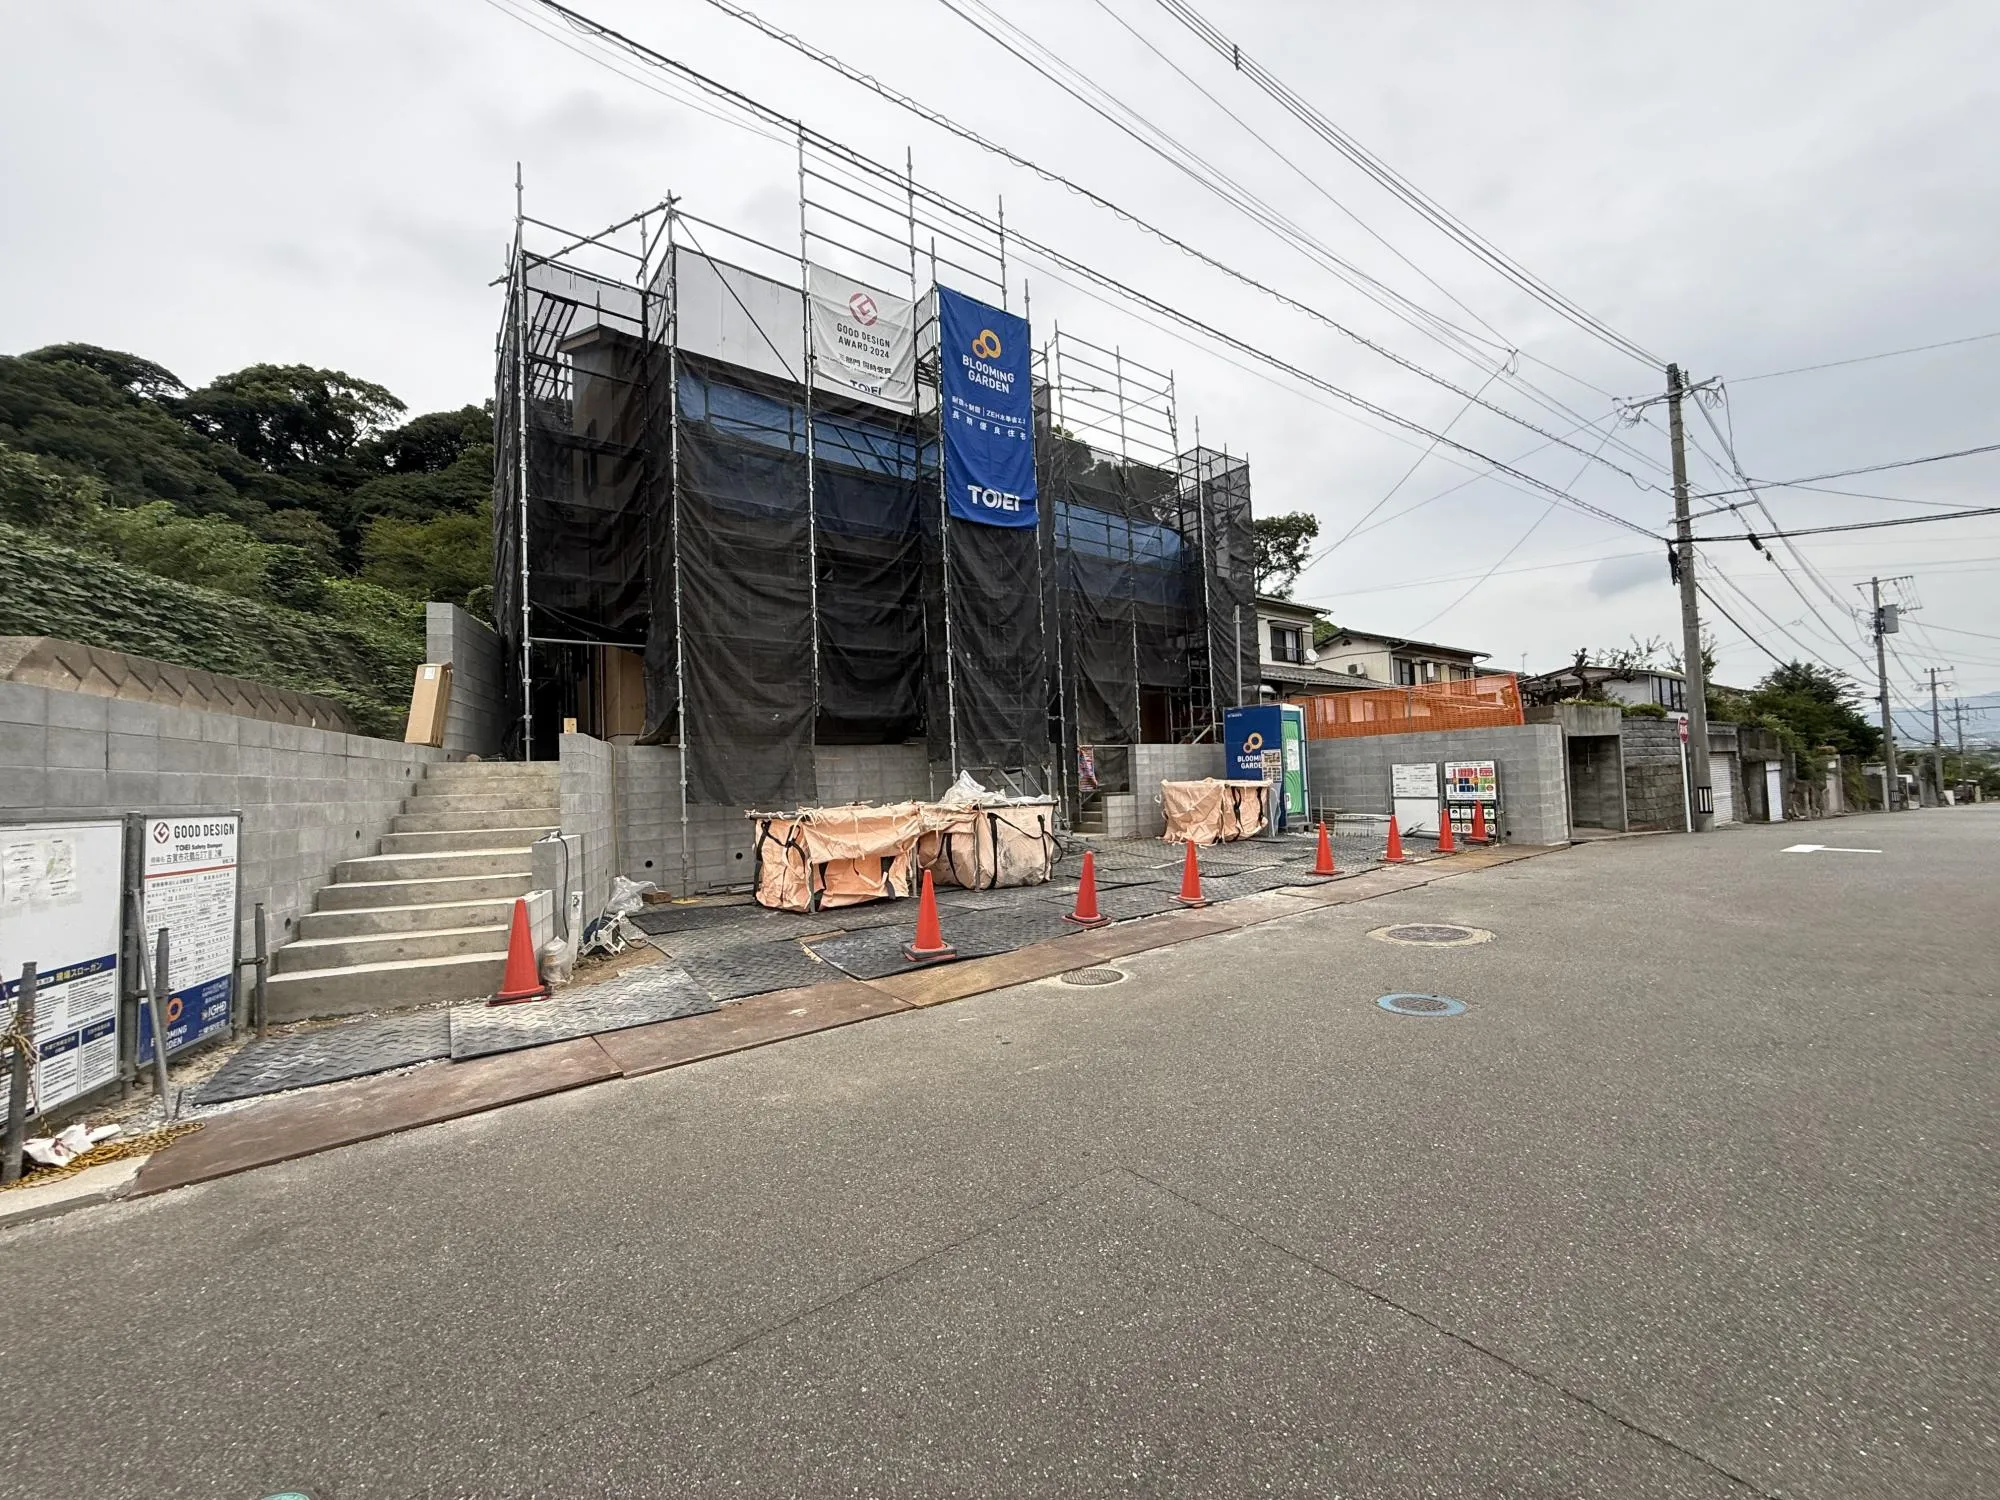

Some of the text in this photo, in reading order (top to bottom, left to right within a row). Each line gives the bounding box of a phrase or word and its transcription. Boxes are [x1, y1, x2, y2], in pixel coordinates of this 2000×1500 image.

[837, 322, 891, 349] GOOD DESIGN
[838, 335, 890, 359] AWARD 2024
[962, 354, 1015, 384] BLOOMING
[968, 369, 1010, 394] GARDEN
[967, 484, 1020, 512] TOEI
[1237, 755, 1262, 763] BLOOM
[174, 823, 235, 839] GOOD DESIGN
